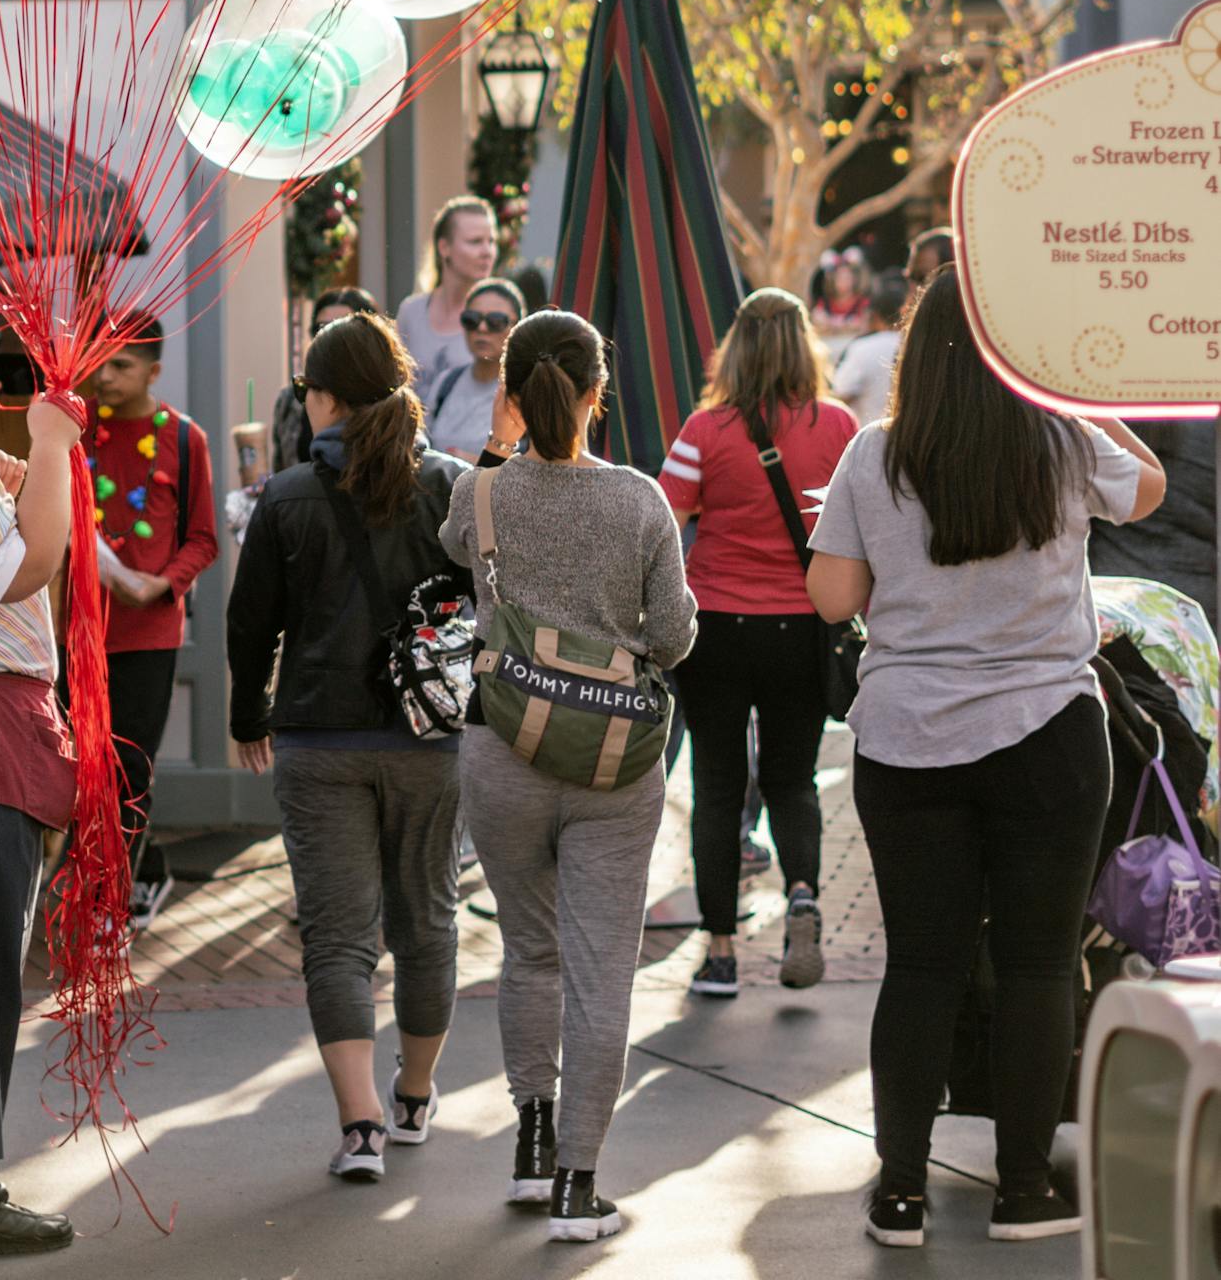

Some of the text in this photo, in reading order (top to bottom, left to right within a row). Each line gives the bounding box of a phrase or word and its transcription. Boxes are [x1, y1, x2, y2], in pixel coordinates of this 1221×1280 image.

[1130, 120, 1205, 140] Frozen
[1072, 145, 1211, 170] or Strawberry
[1042, 220, 1123, 244] Nestlé
[1050, 249, 1187, 263] Bite Sized Snacks
[1099, 270, 1149, 290] 5.50
[504, 653, 571, 696] TOMMY
